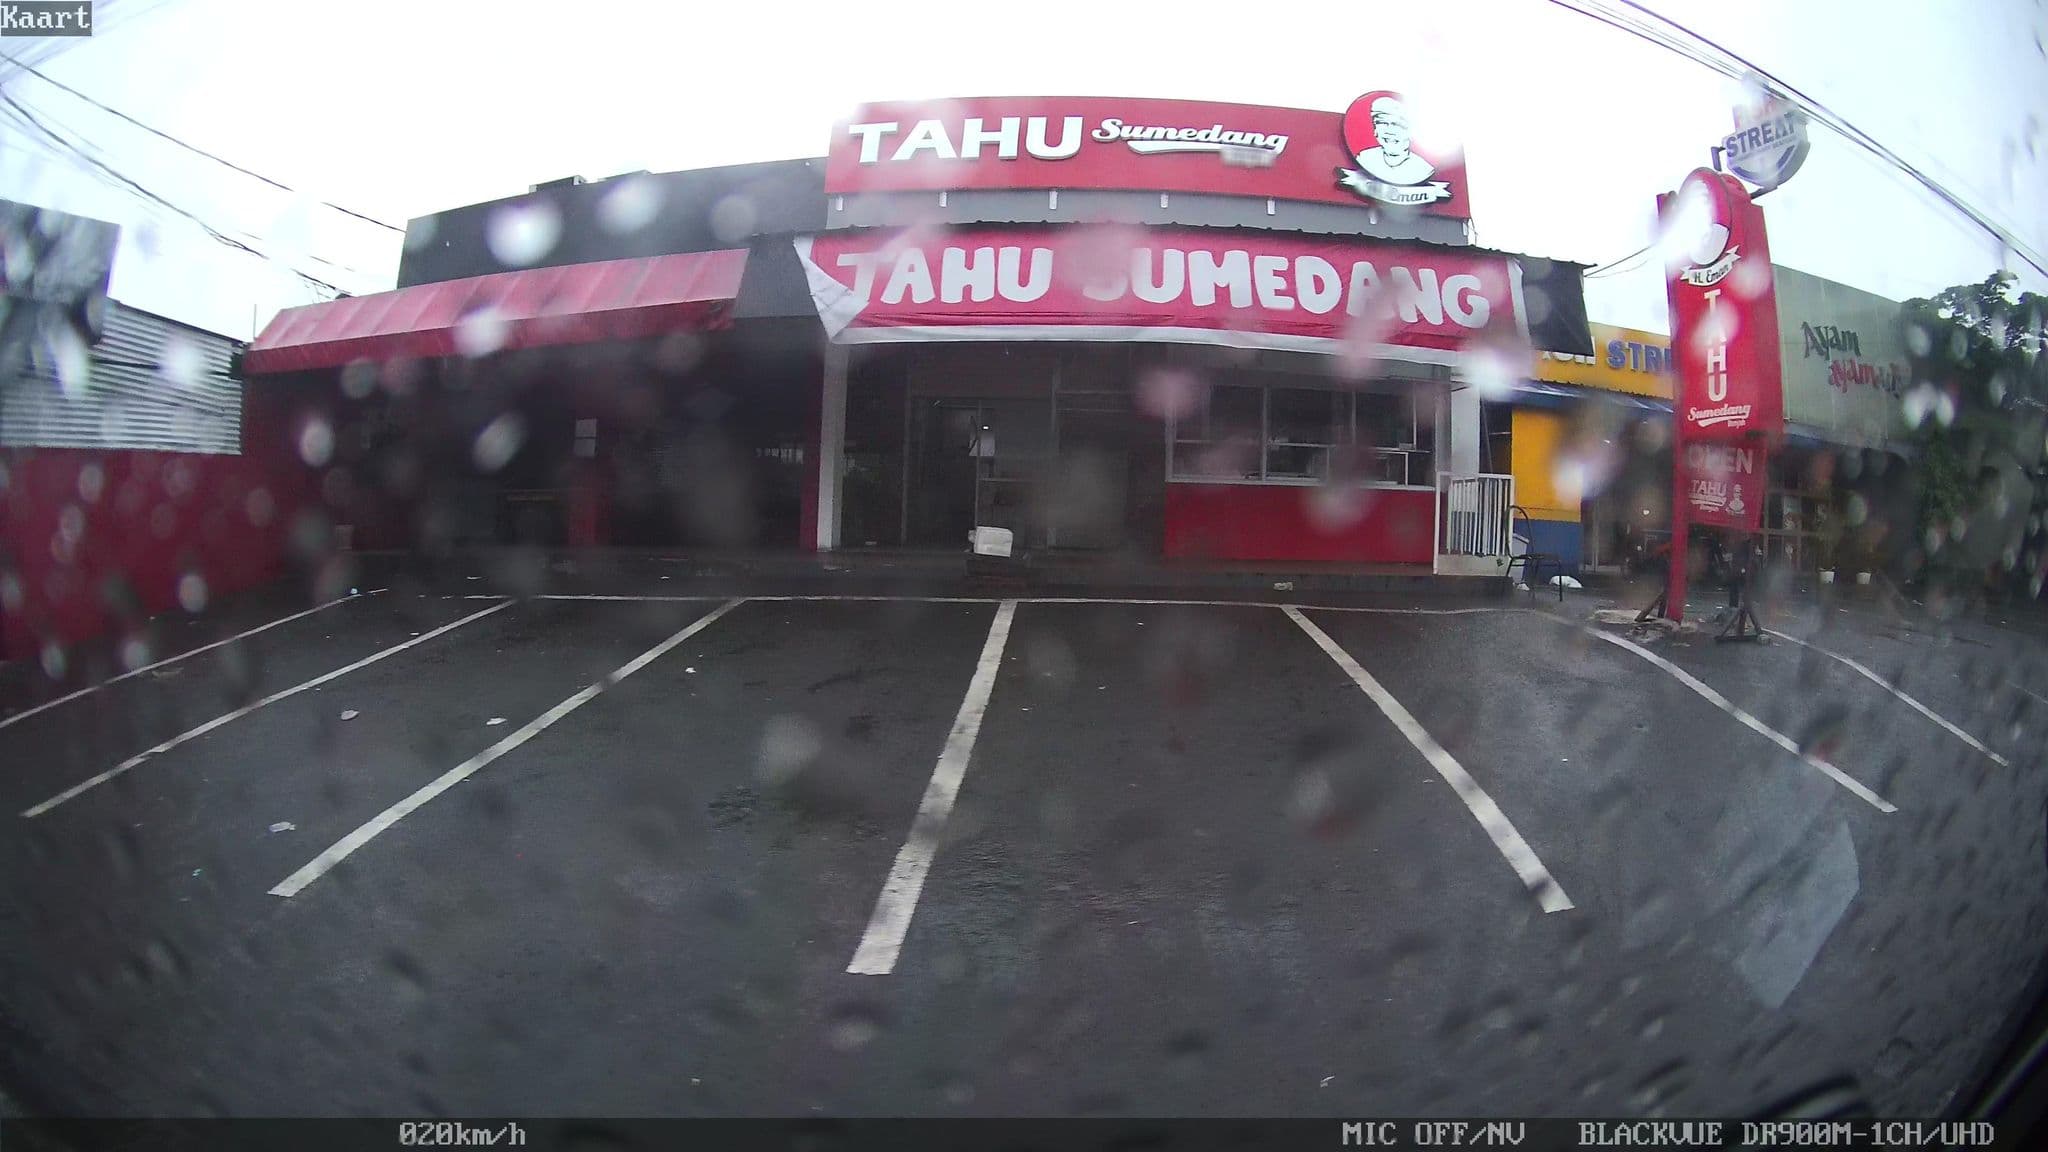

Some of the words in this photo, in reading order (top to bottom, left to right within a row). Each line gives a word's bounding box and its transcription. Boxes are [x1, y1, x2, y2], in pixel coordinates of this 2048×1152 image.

[848, 116, 1083, 164] TAHU
[1091, 118, 1289, 154] Sumedang
[836, 246, 1054, 304] TAHU
[1703, 288, 1728, 402] THU
[1801, 321, 1862, 360] Ayam
[1687, 445, 1754, 475] OEN
[1690, 479, 1727, 497] TAHU
